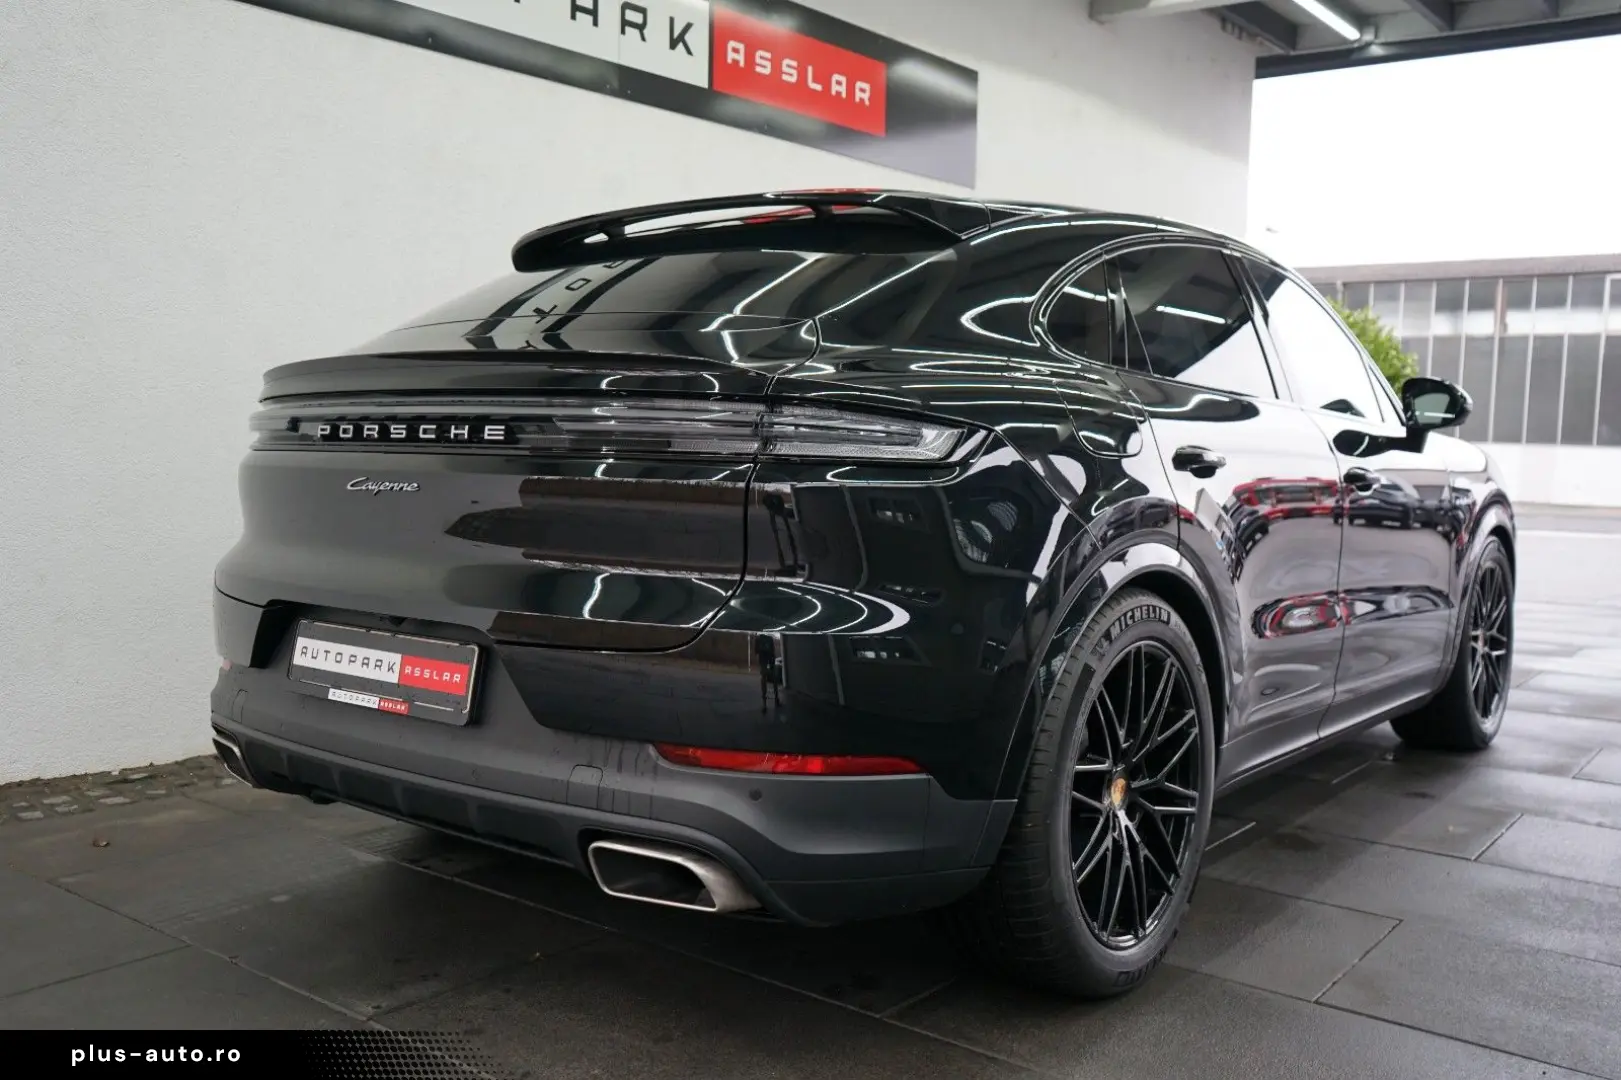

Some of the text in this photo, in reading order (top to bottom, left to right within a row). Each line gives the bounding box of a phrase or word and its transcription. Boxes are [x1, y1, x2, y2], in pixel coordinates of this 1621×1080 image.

[513, 0, 871, 107] ARK ASSLAR
[317, 424, 506, 440] PORSCHE
[346, 476, 420, 495] Cayenne
[1109, 605, 1169, 640] MICHELIN
[300, 645, 462, 683] AUTOPARK ASSLAR
